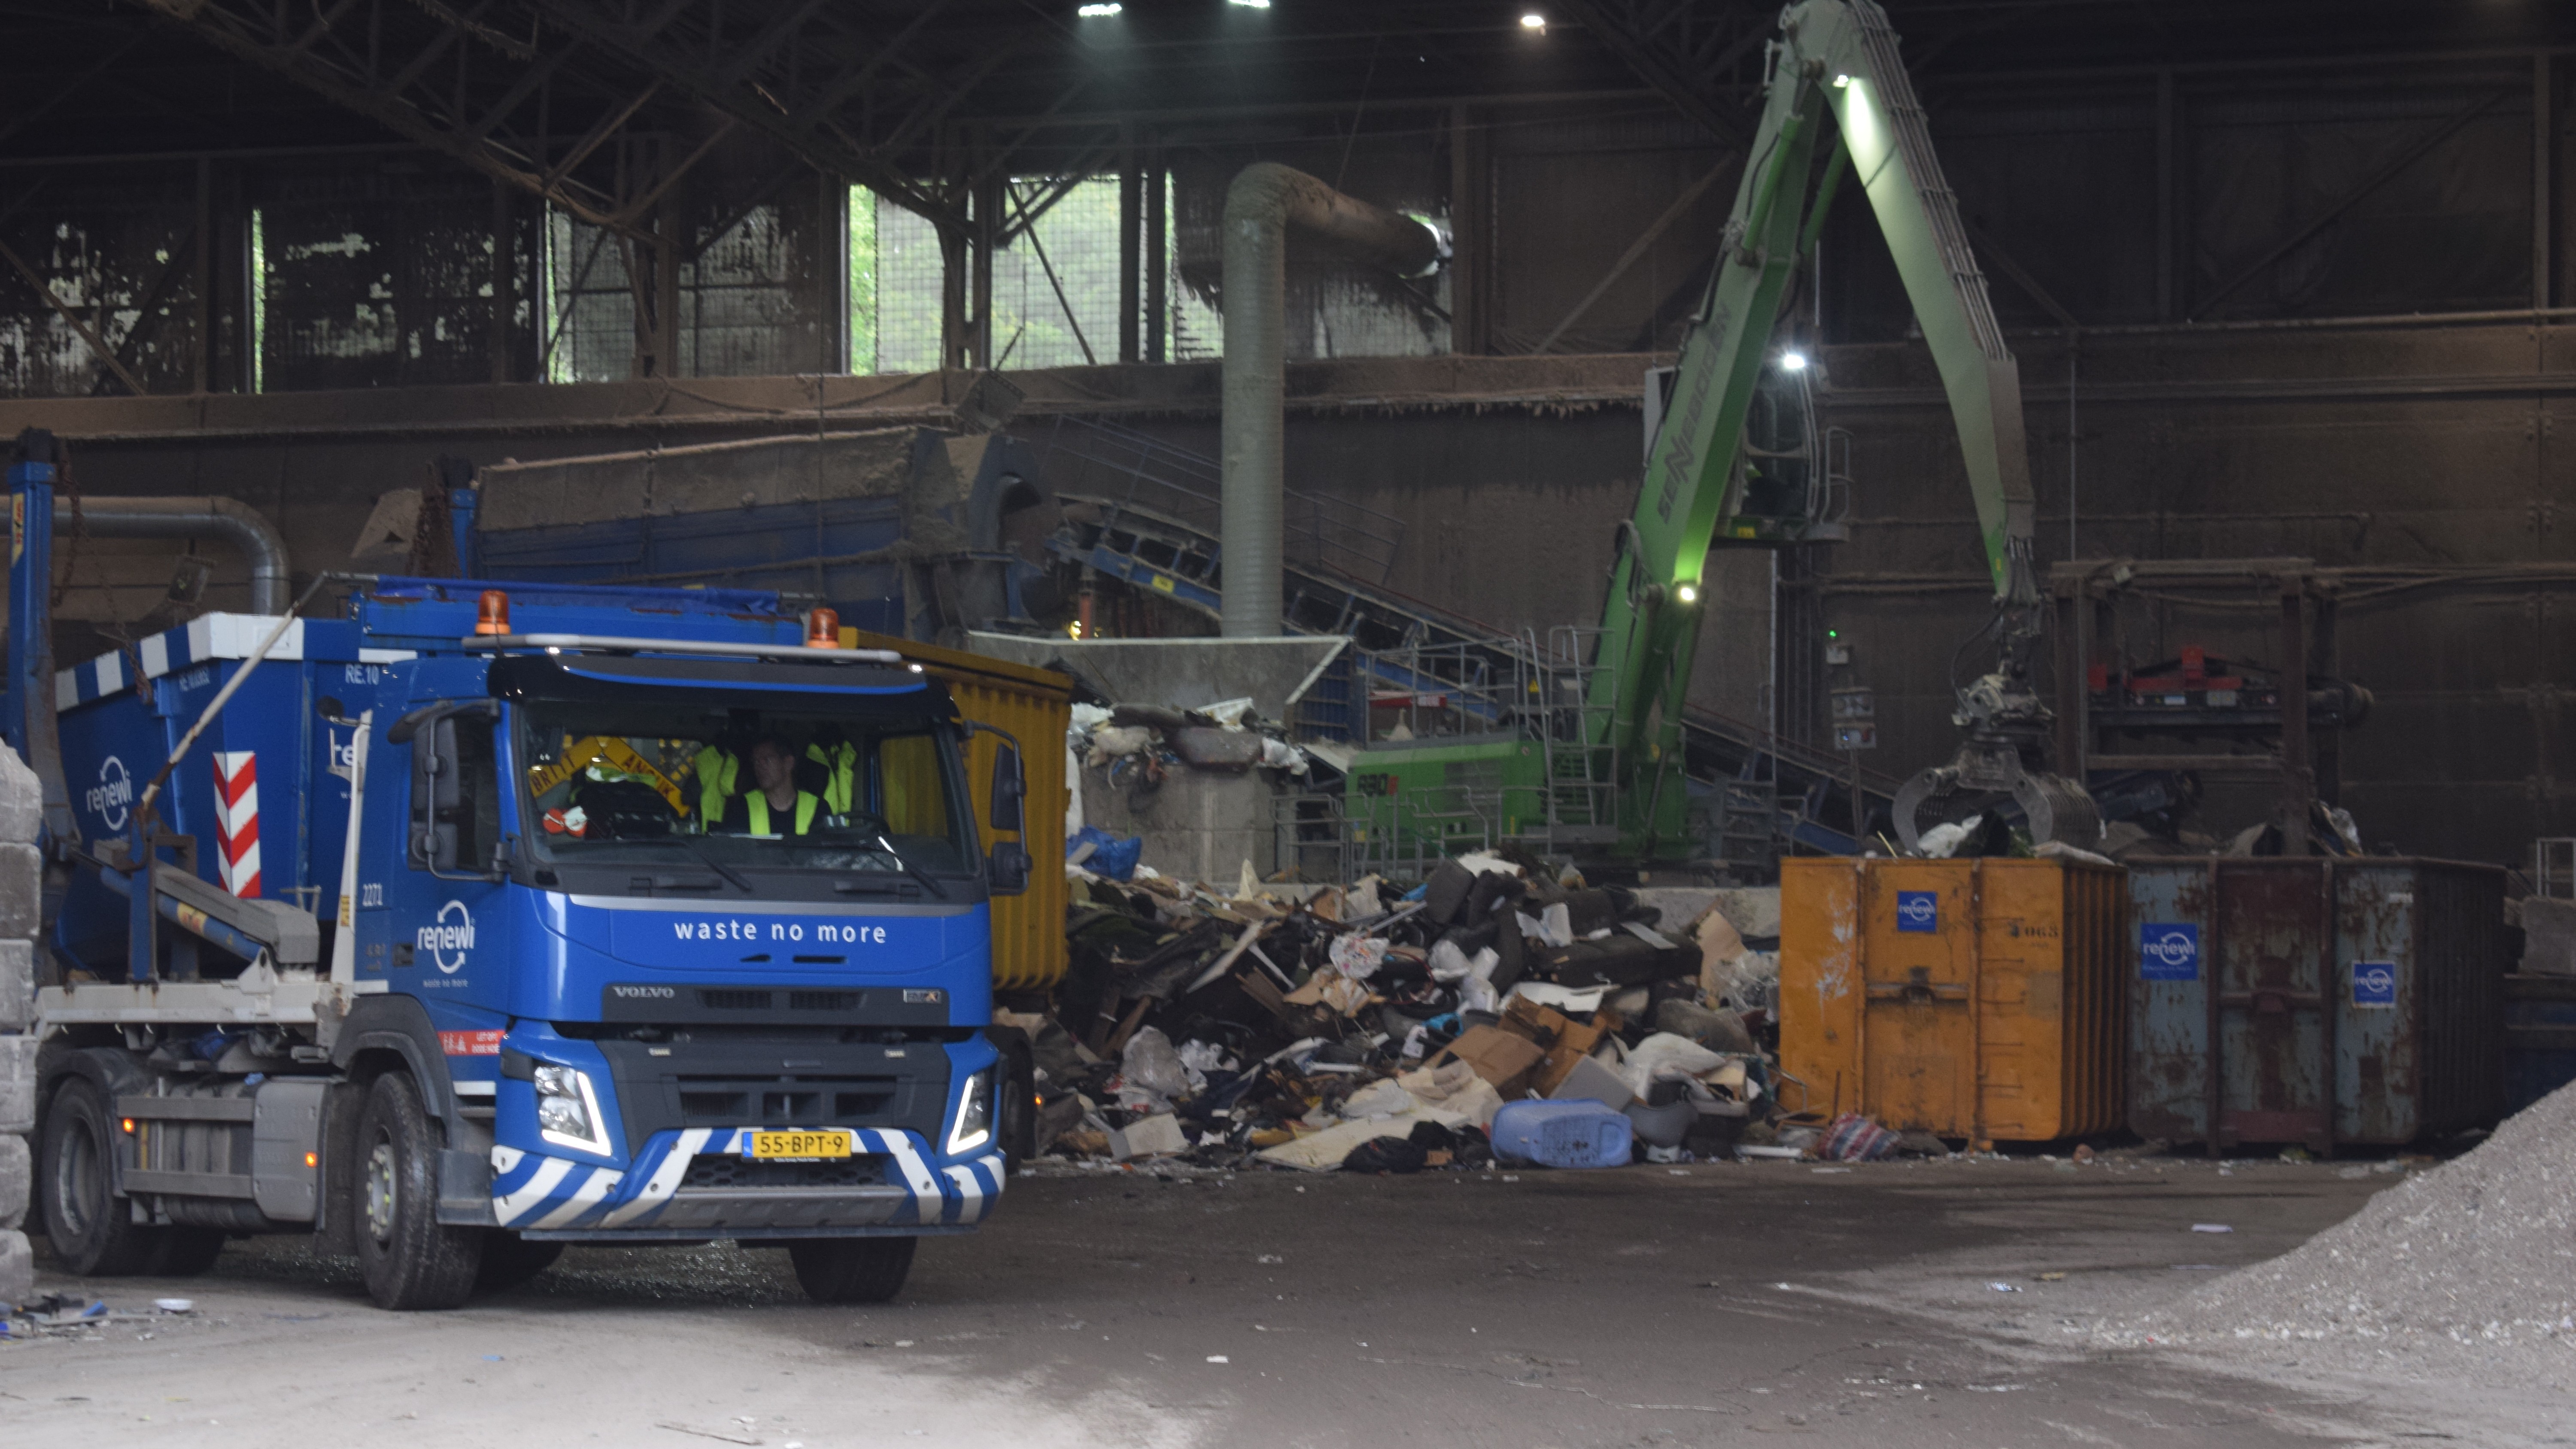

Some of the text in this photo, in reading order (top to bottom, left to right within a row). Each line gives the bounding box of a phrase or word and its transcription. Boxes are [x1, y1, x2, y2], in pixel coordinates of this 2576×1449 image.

[86, 770, 132, 813] renewi
[417, 924, 475, 950] renewi
[674, 919, 886, 944] waste no more
[613, 986, 675, 998] VOLVO
[760, 1136, 843, 1154] 55-BPT-9
